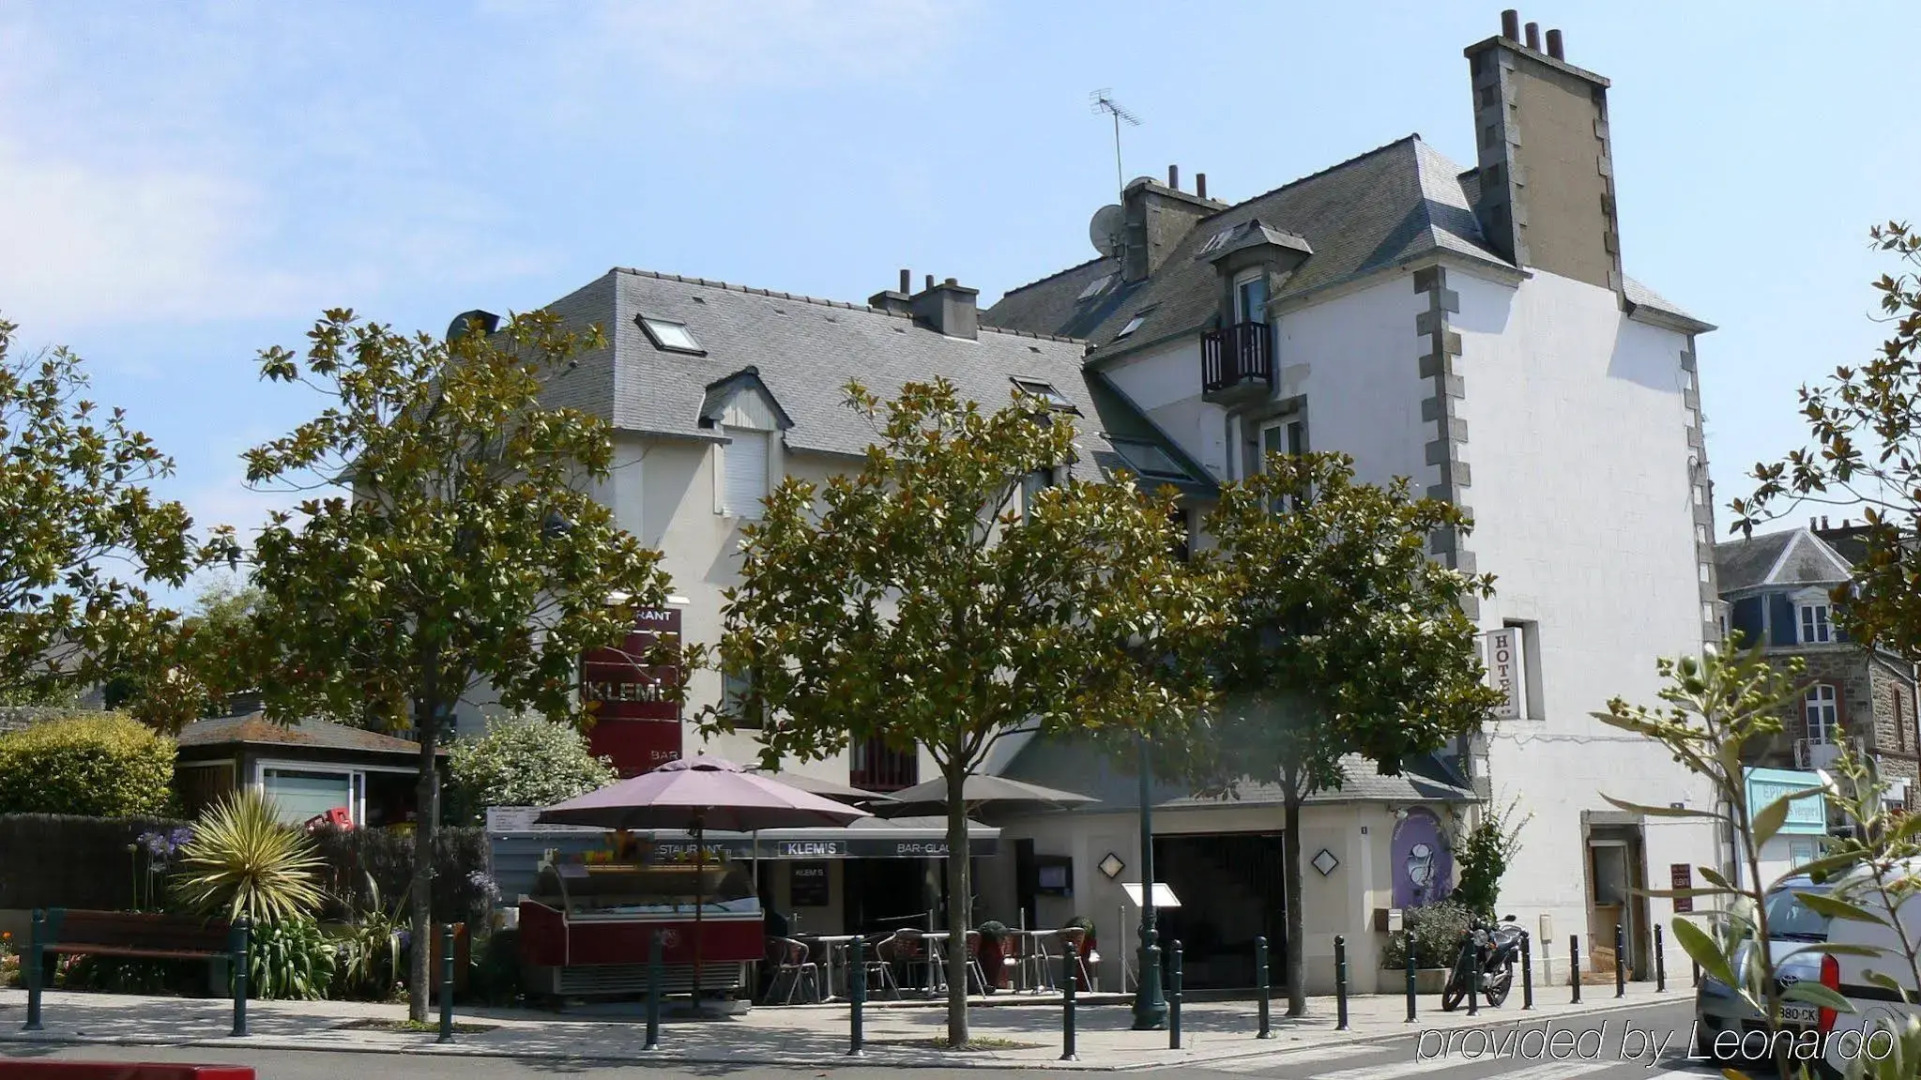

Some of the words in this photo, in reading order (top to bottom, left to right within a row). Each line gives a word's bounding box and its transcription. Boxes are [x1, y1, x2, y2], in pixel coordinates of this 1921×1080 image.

[636, 611, 671, 621] RANT
[1495, 634, 1512, 708] HOTEL
[651, 750, 678, 760] BAR
[787, 842, 837, 855] KLEM'S
